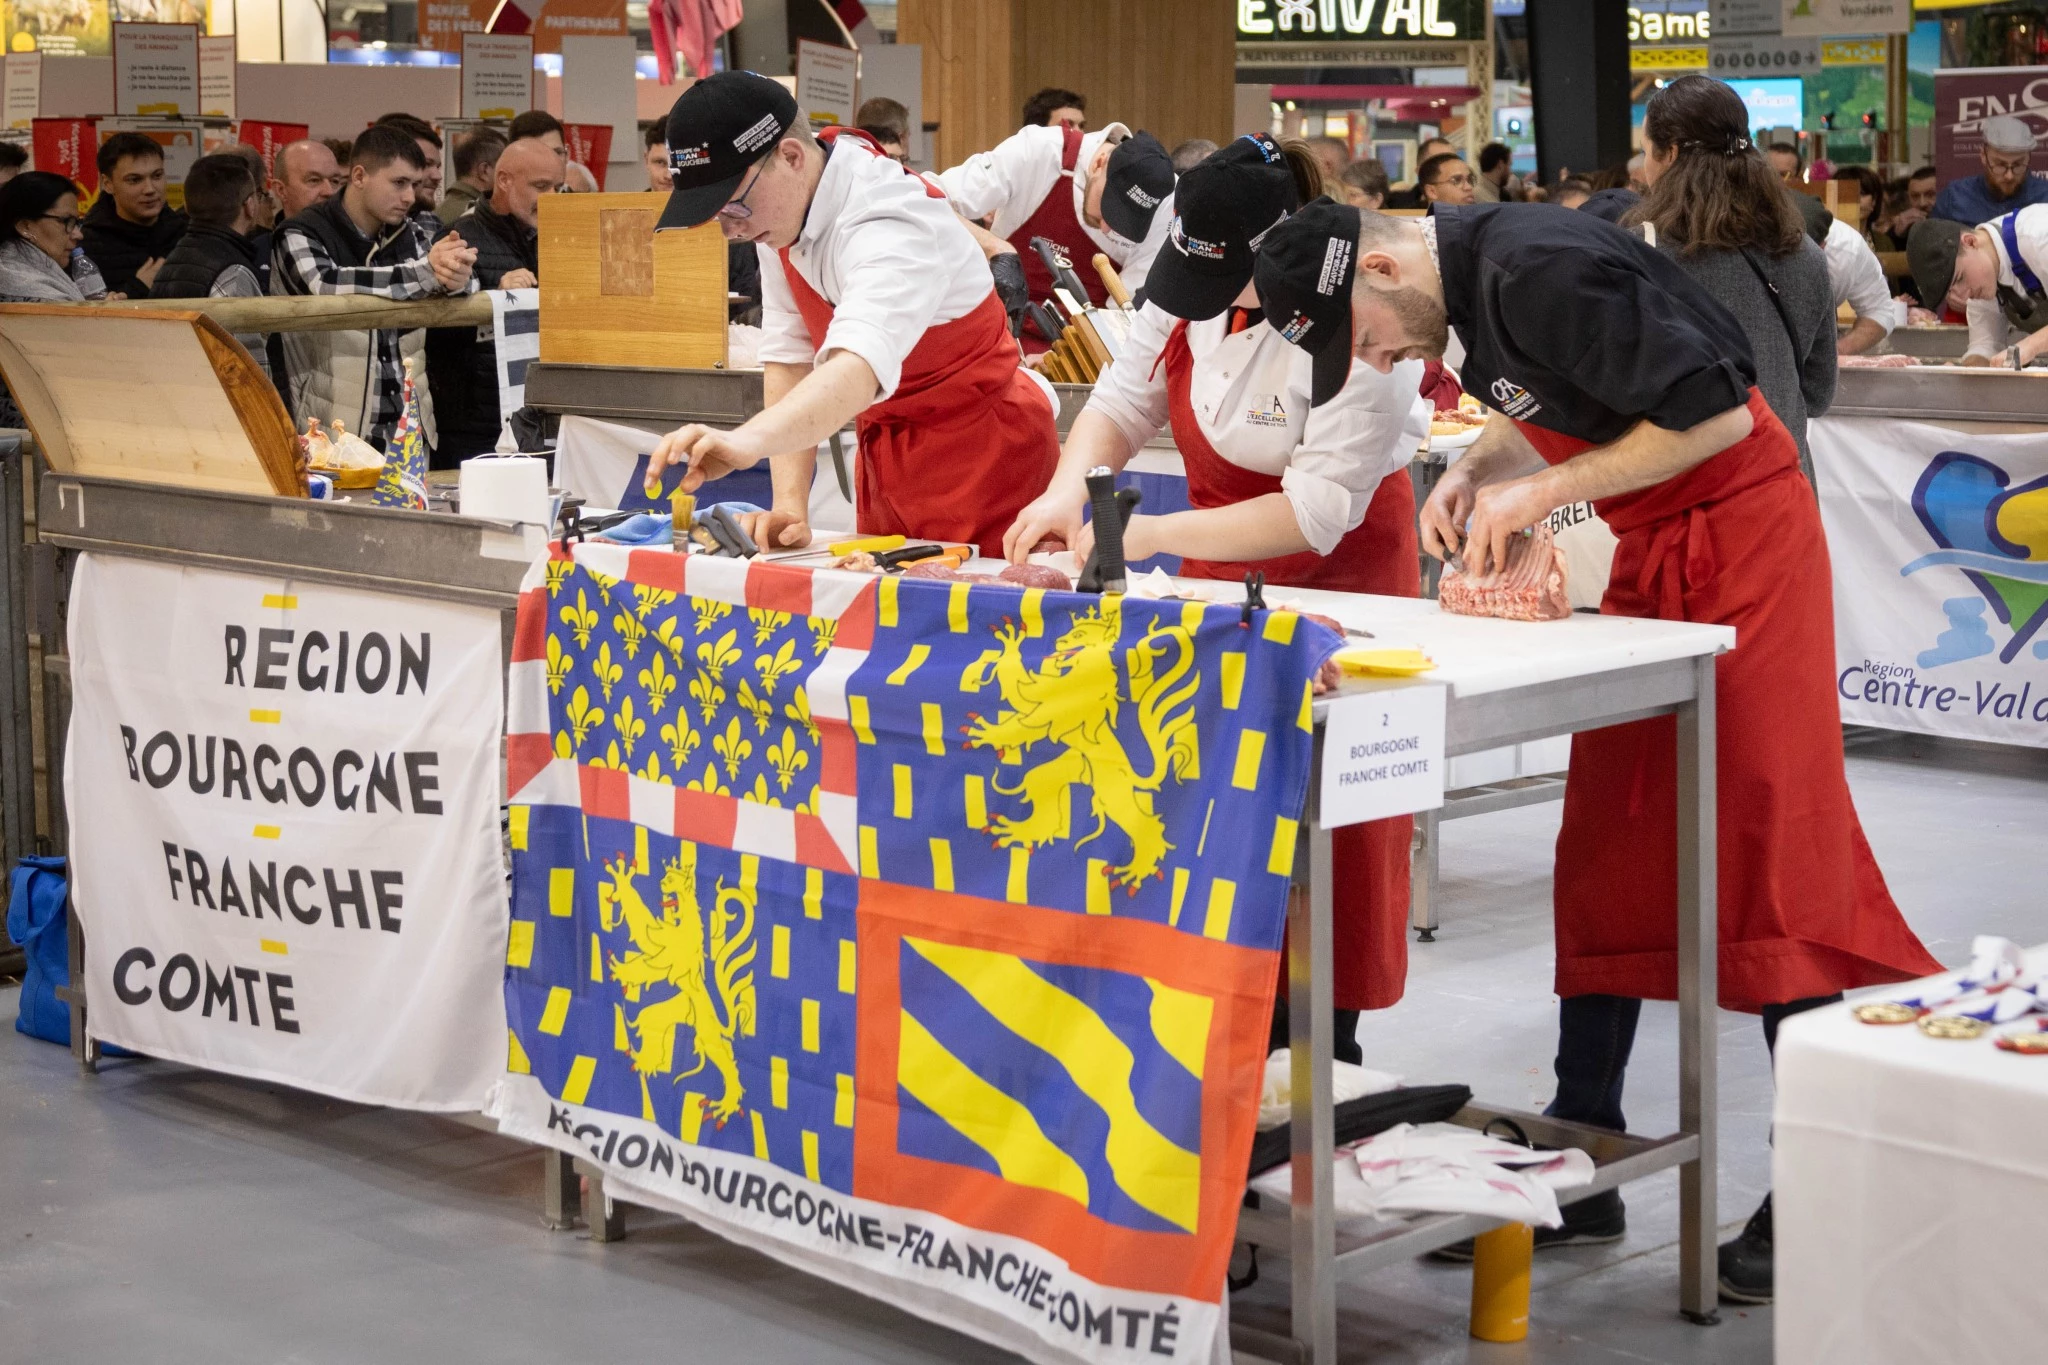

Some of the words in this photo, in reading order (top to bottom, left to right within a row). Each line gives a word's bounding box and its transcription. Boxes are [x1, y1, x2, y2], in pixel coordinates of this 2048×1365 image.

[676, 151, 709, 161] FRANCE
[1187, 246, 1225, 259] BOUCHERIE
[1188, 241, 1225, 254] FRANCE
[1329, 239, 1345, 285] SAVOIR-FAIRE
[1284, 315, 1308, 340] FRANCE
[1247, 413, 1287, 423] L'EXCELLENCE
[224, 624, 431, 696] REGION
[1863, 659, 1914, 680] Région
[1838, 665, 2031, 720] Centre-Val
[1382, 713, 1389, 727] 2
[1350, 736, 1420, 760] BOURGOGNE
[119, 723, 444, 815] BOURGOGNE
[1339, 766, 1388, 786] FRANCHE
[1391, 759, 1429, 778] COMTE
[161, 840, 404, 934] FRANCHE
[112, 946, 301, 1034] COMTE
